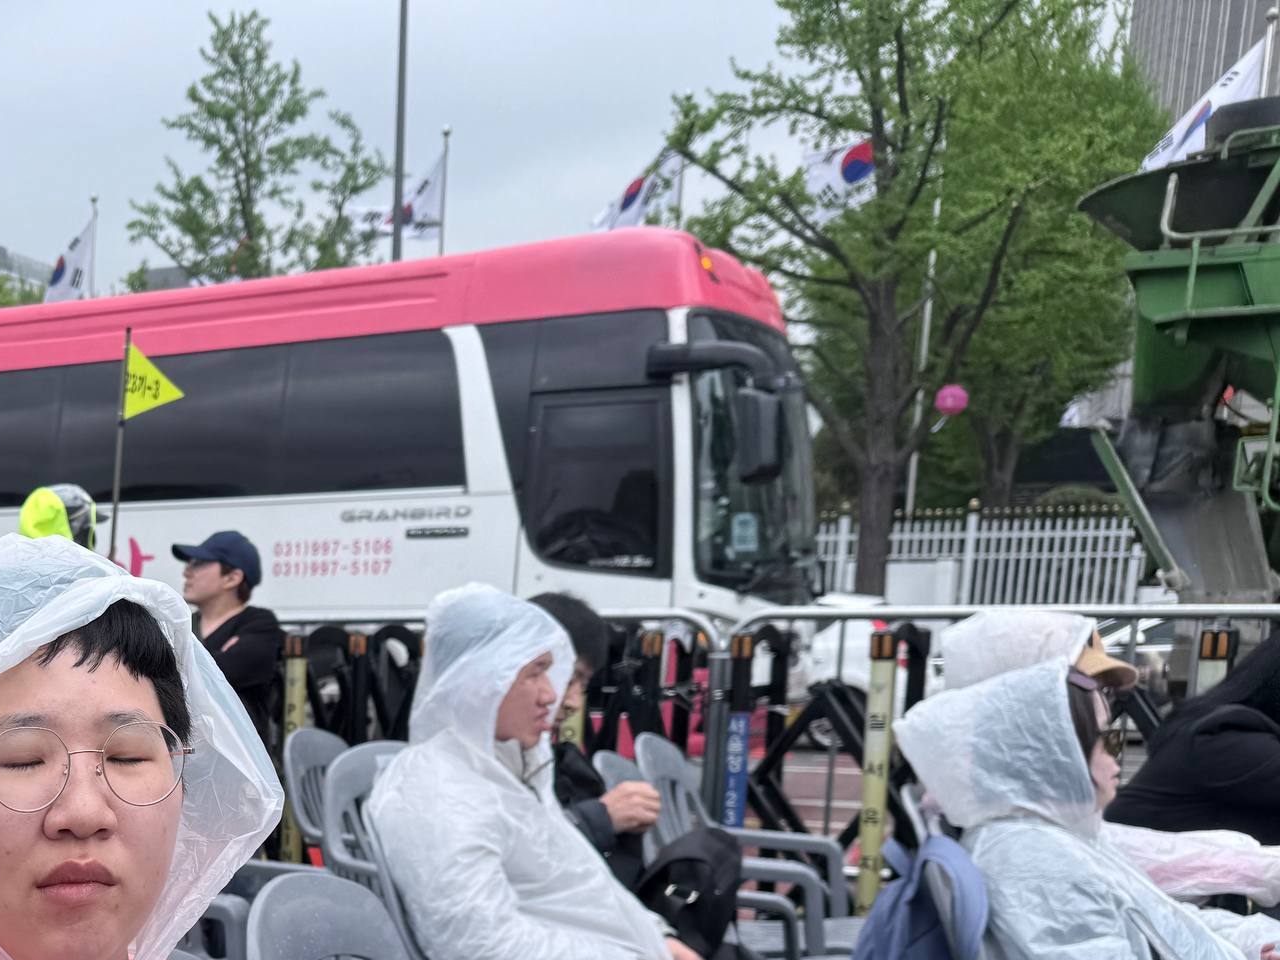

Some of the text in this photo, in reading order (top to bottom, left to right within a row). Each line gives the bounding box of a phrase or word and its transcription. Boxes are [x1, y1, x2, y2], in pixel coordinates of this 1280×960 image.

[341, 506, 470, 522] GRANBIRD
[273, 540, 393, 556] 031)997-5106
[272, 560, 391, 577] 031)997-5107
